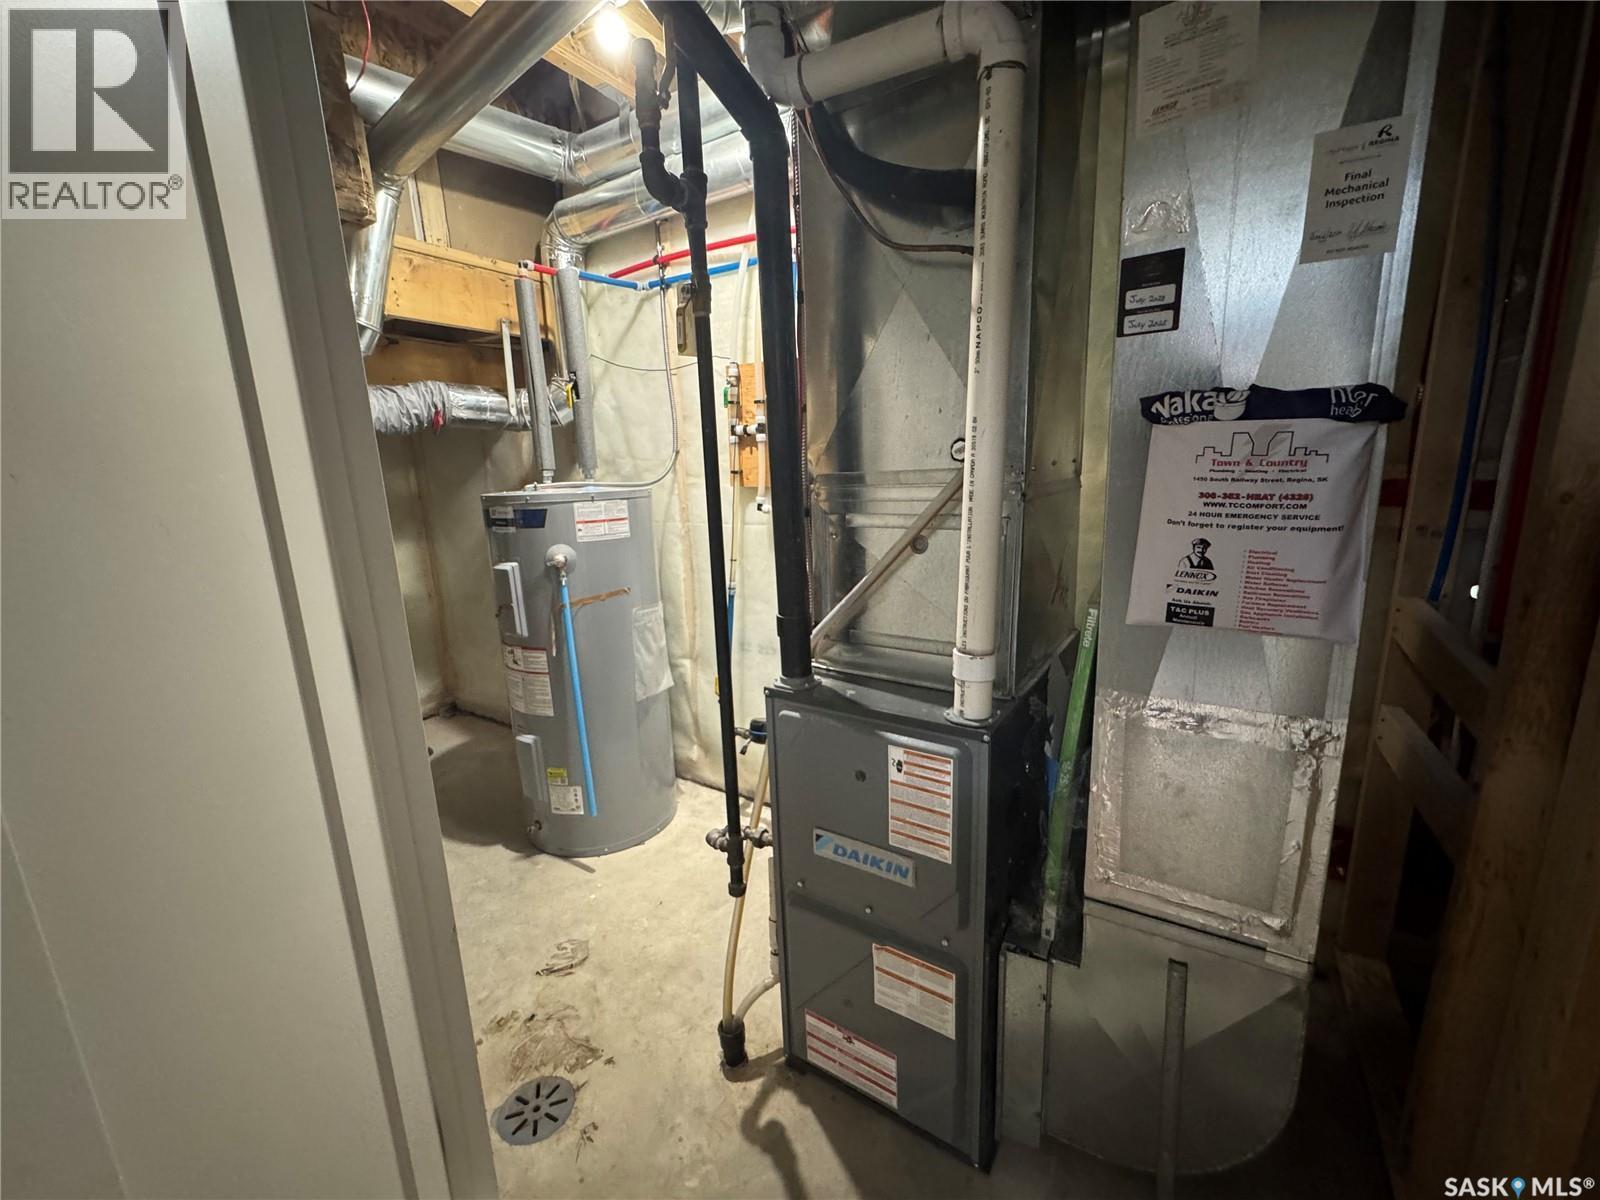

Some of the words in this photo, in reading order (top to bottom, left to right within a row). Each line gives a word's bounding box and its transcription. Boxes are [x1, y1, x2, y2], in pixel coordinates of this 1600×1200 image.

[1344, 168, 1373, 182] Final
[1324, 178, 1390, 197] Mechanical
[1325, 192, 1385, 209] Inspection
[1211, 458, 1240, 467] Town
[1246, 458, 1252, 467] &
[1260, 458, 1308, 468] Country
[1230, 476, 1258, 486] Railway
[1202, 502, 1308, 510] WWW.TCCOMFORT.COM
[1225, 512, 1278, 520] EMERGENCY
[1188, 520, 1214, 530] forget
[1228, 523, 1264, 532] register
[1290, 525, 1345, 534] equipment!
[1174, 570, 1207, 580] LENNOX
[1176, 588, 1220, 597] DAIKIN
[1083, 608, 1098, 648] Filtrete
[832, 843, 910, 879] DAIKIN
